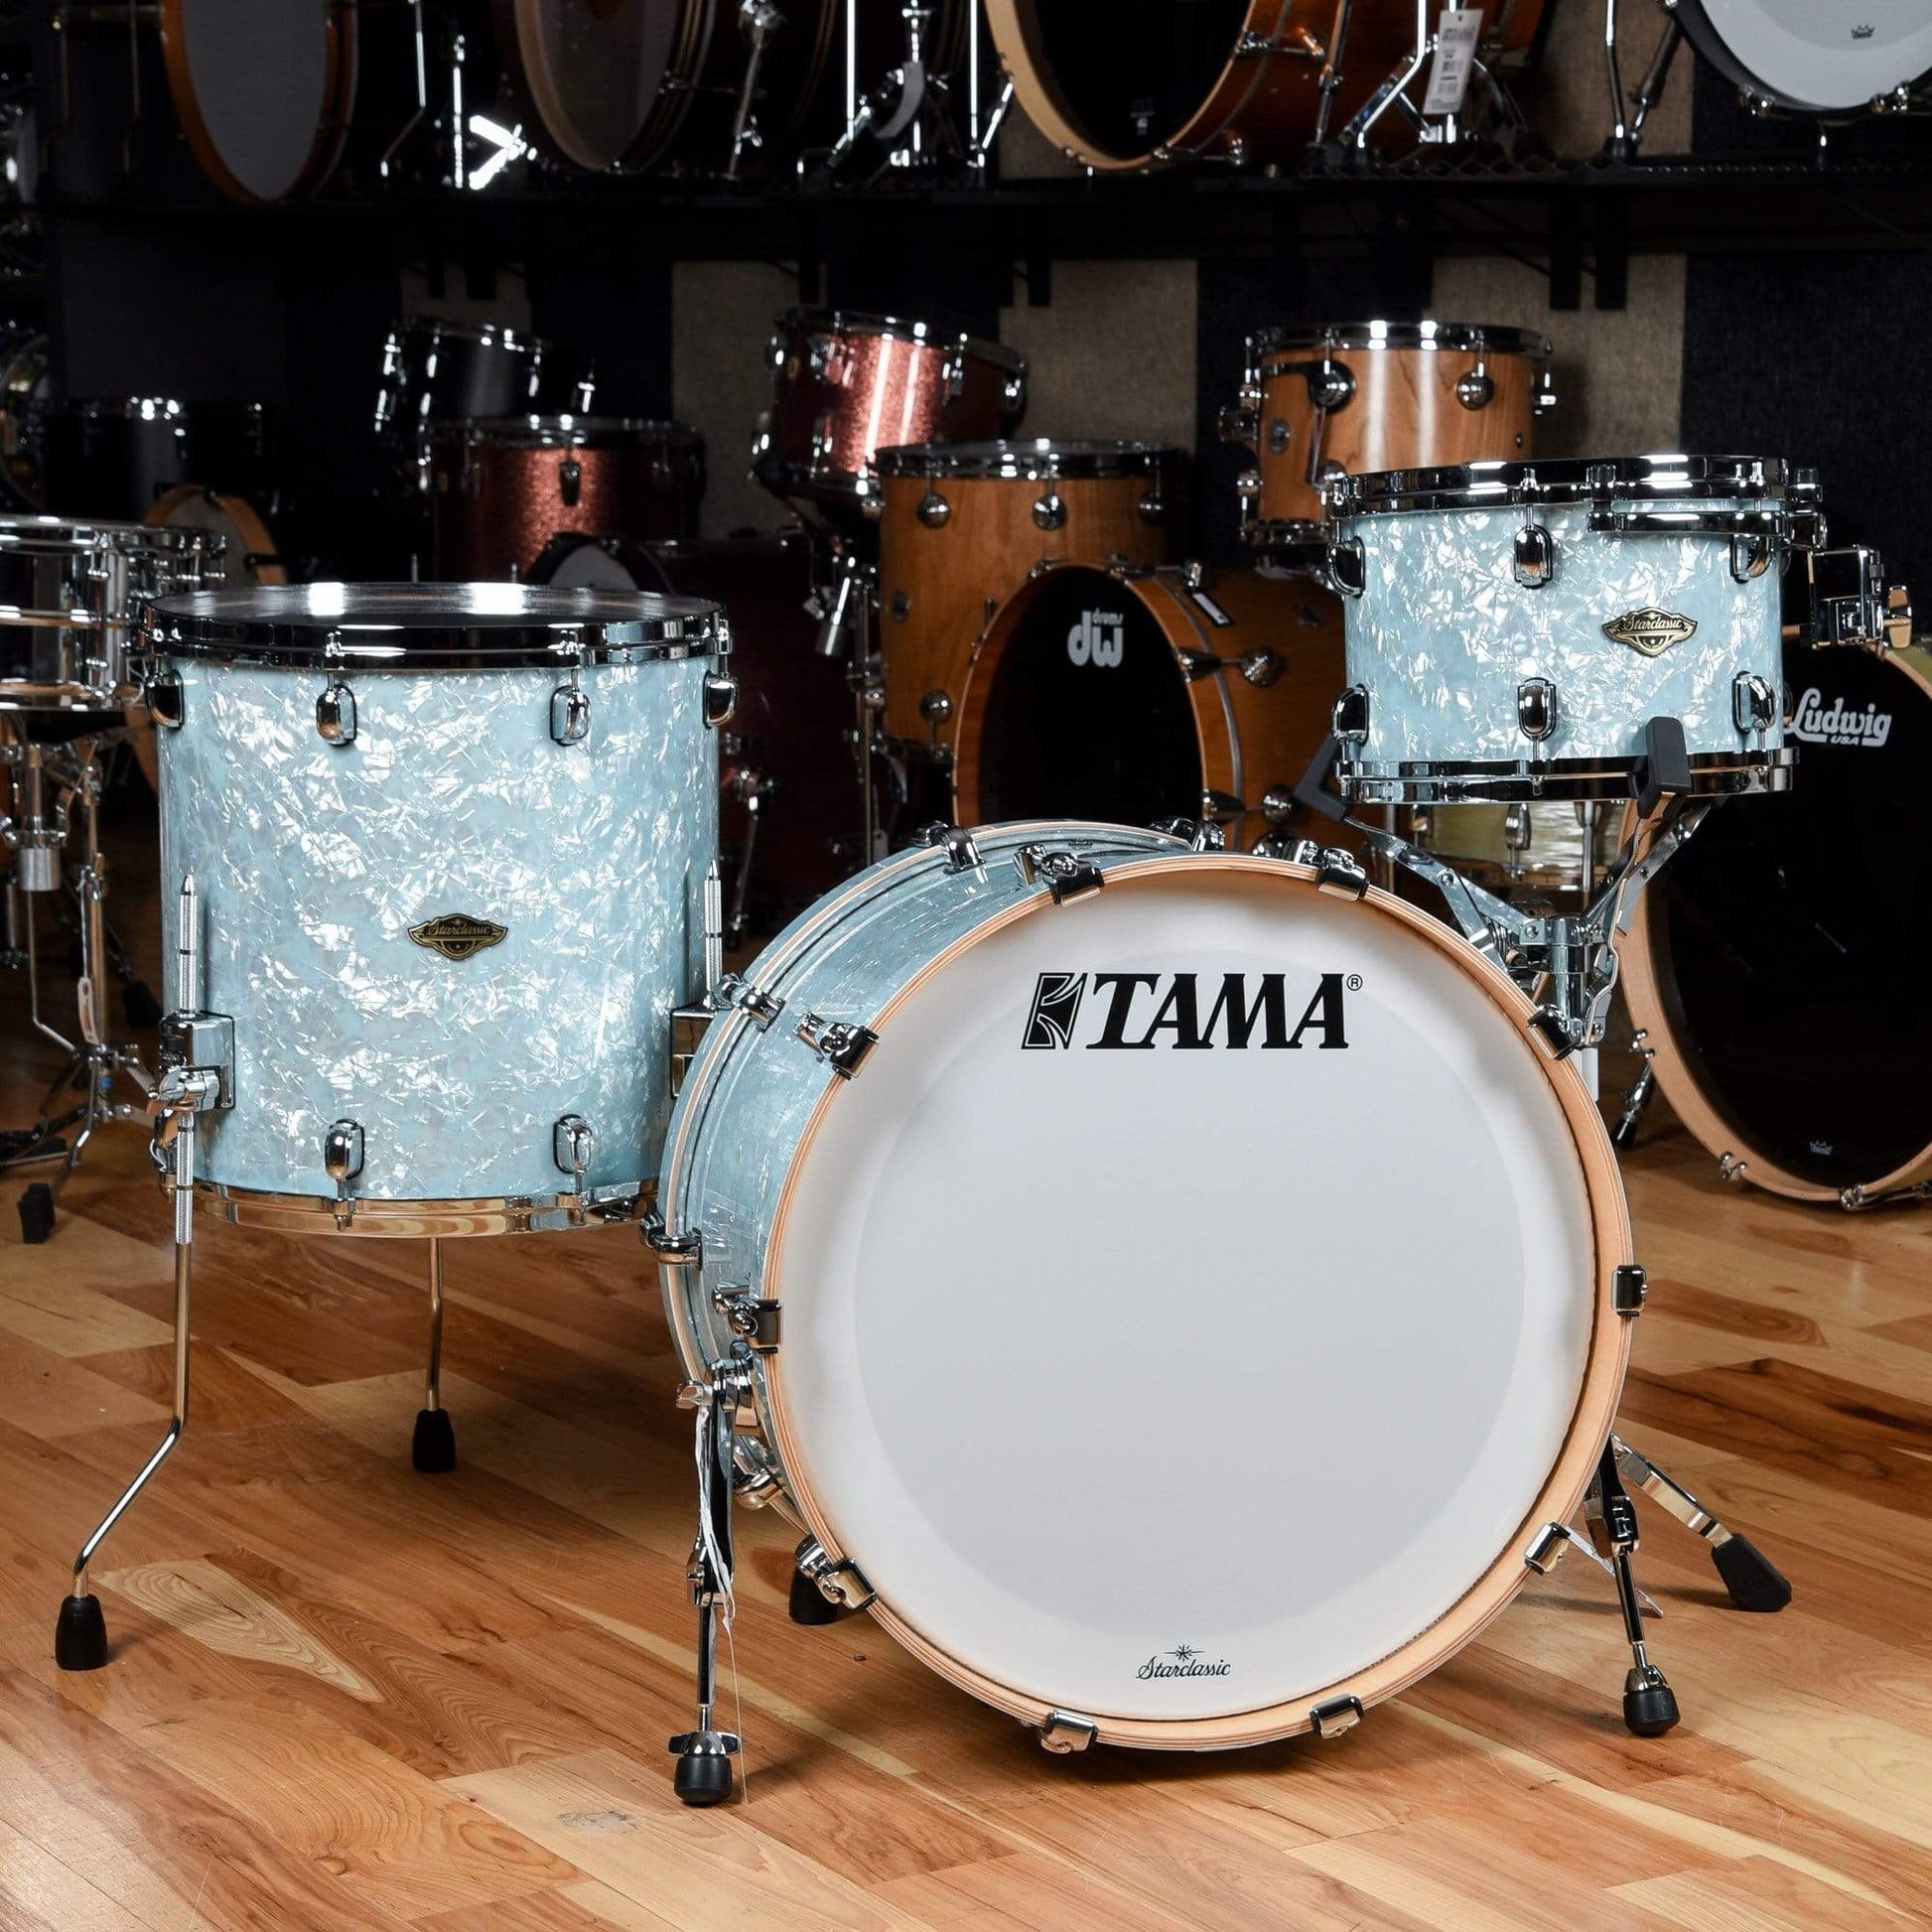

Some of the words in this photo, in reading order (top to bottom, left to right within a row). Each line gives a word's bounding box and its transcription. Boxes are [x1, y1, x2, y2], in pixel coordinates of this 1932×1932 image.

[1623, 615, 1683, 631] Starclassic
[1067, 611, 1123, 667] dw
[1785, 687, 1892, 748] Ludwig
[1830, 736, 1860, 746] USA
[428, 920, 490, 936] Starclassic
[1085, 973, 1349, 1049] TAMA
[1135, 1655, 1231, 1680] Starclassic
